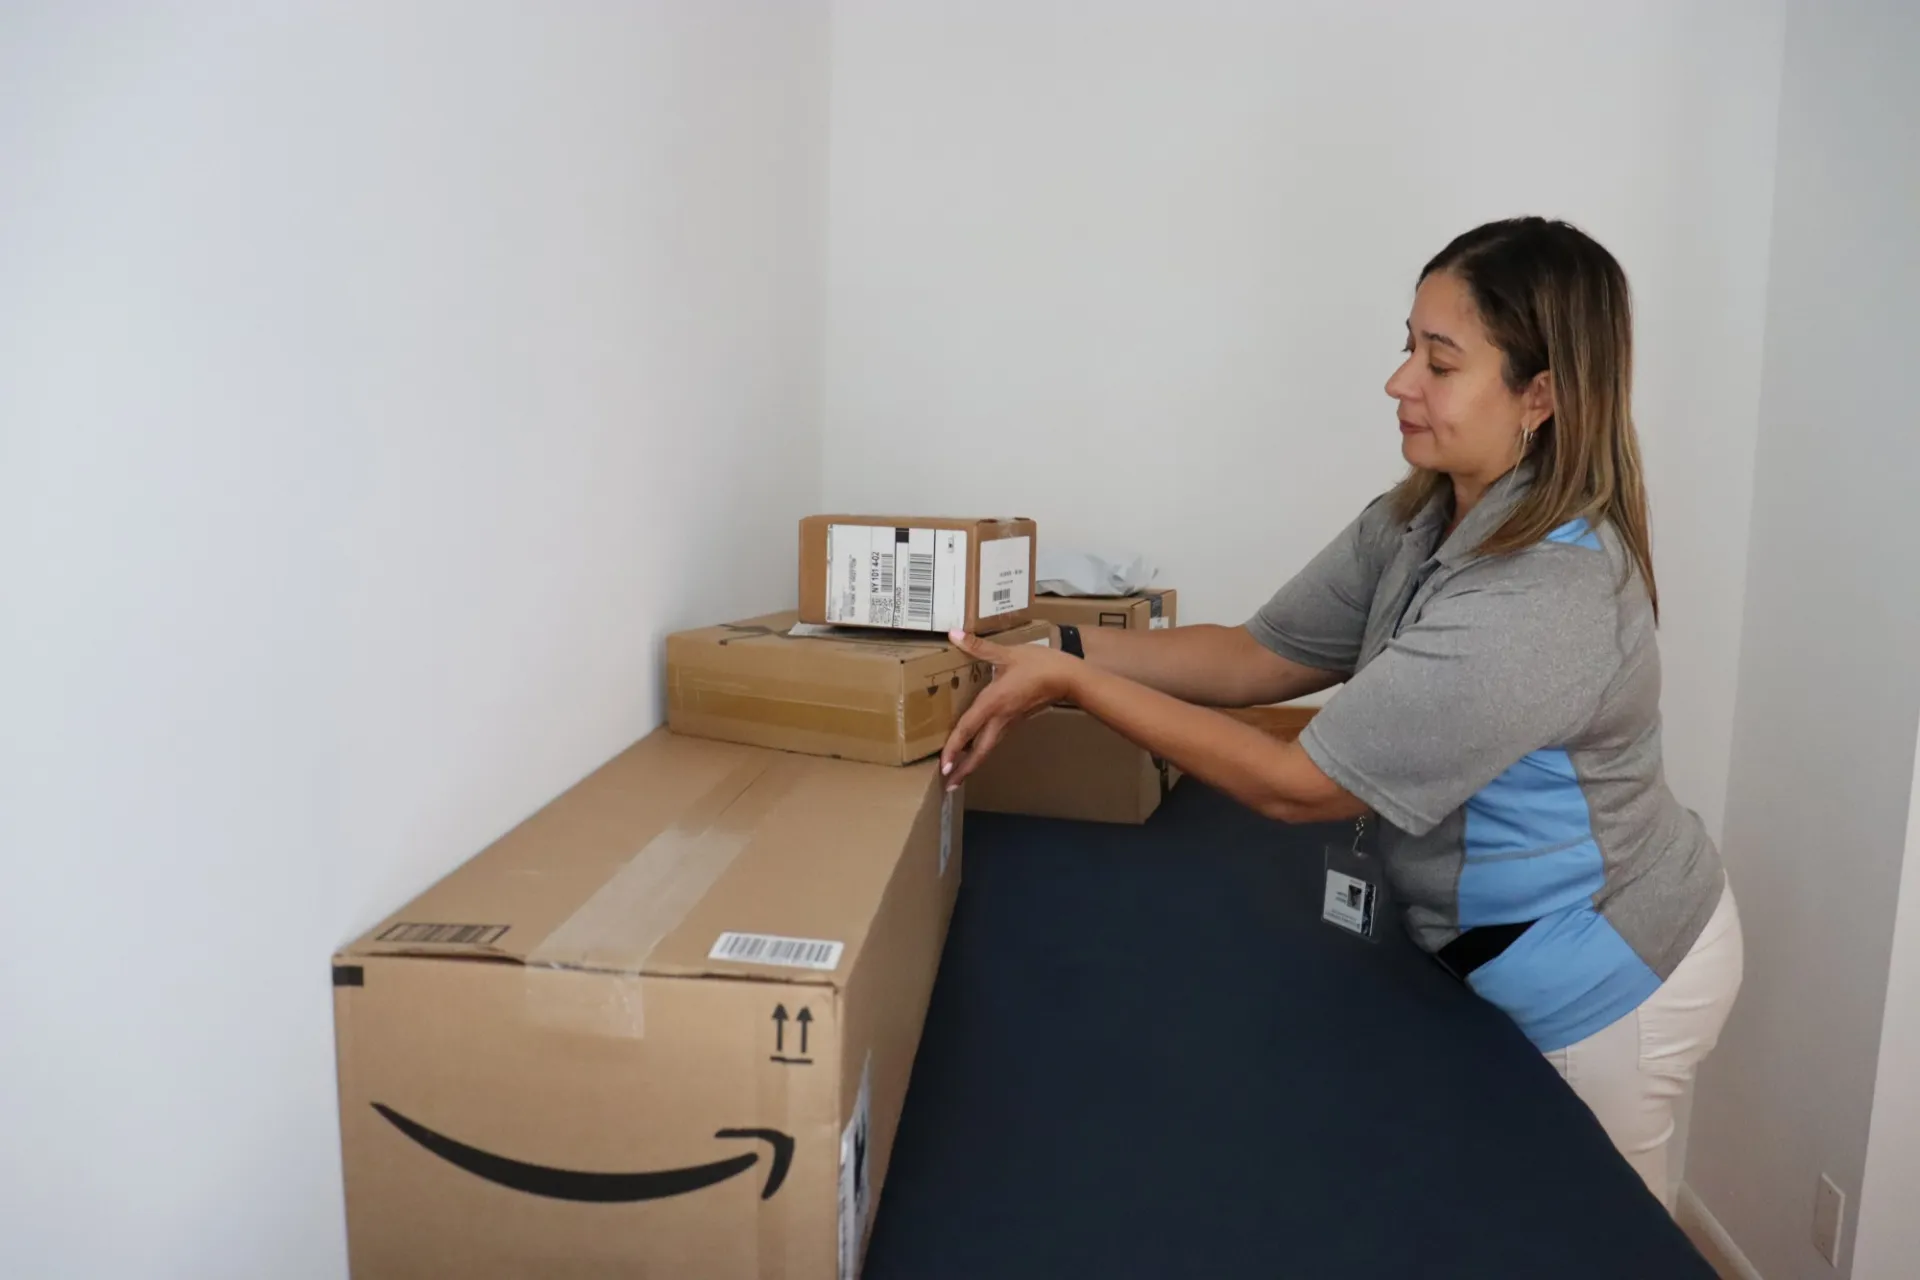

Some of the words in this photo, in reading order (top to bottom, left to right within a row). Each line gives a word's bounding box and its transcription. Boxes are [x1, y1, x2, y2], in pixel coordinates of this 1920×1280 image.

[872, 551, 880, 567] 4-02
[871, 569, 879, 581] 101
[871, 583, 879, 593] NY
